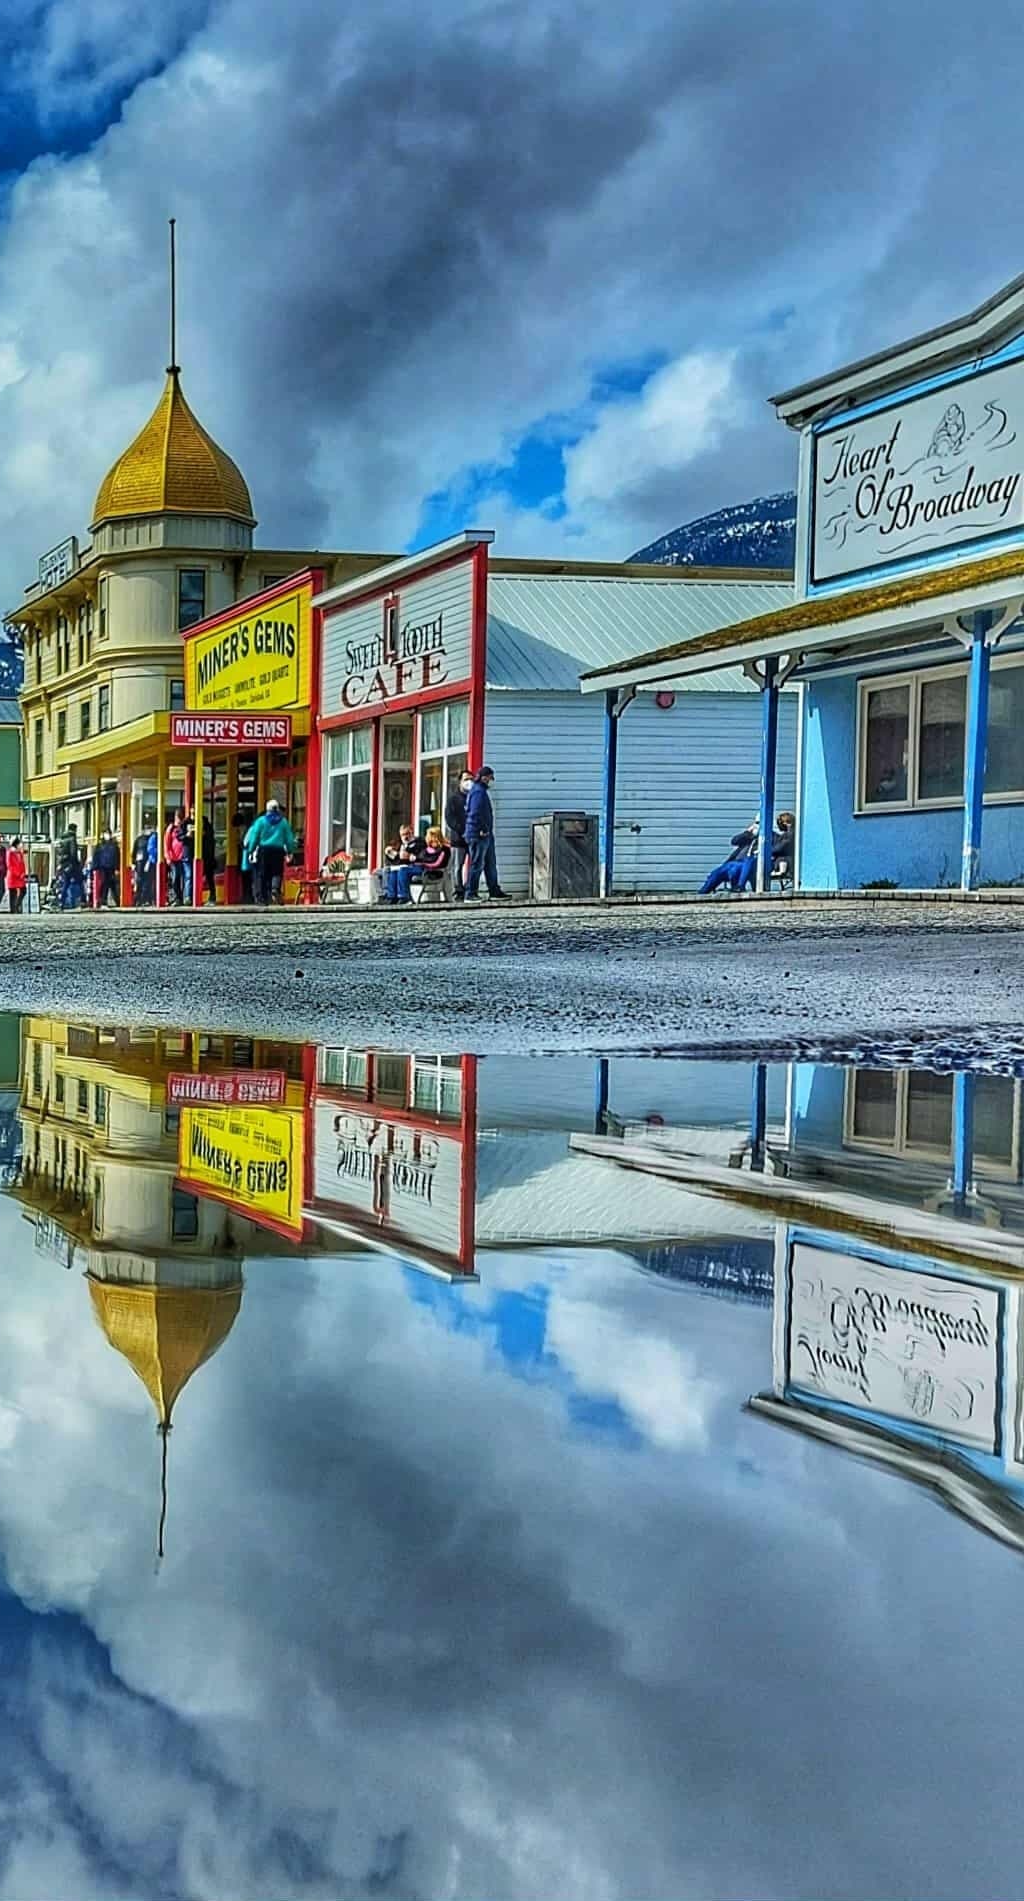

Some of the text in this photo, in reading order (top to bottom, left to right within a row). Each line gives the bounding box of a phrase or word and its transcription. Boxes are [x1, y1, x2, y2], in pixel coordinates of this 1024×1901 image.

[823, 419, 902, 485] Heart
[855, 465, 1020, 535] Of Broadway
[198, 619, 295, 695] MINER'S GEMS
[342, 648, 449, 708] CAFE
[176, 719, 286, 738] MINER'S GEMS
